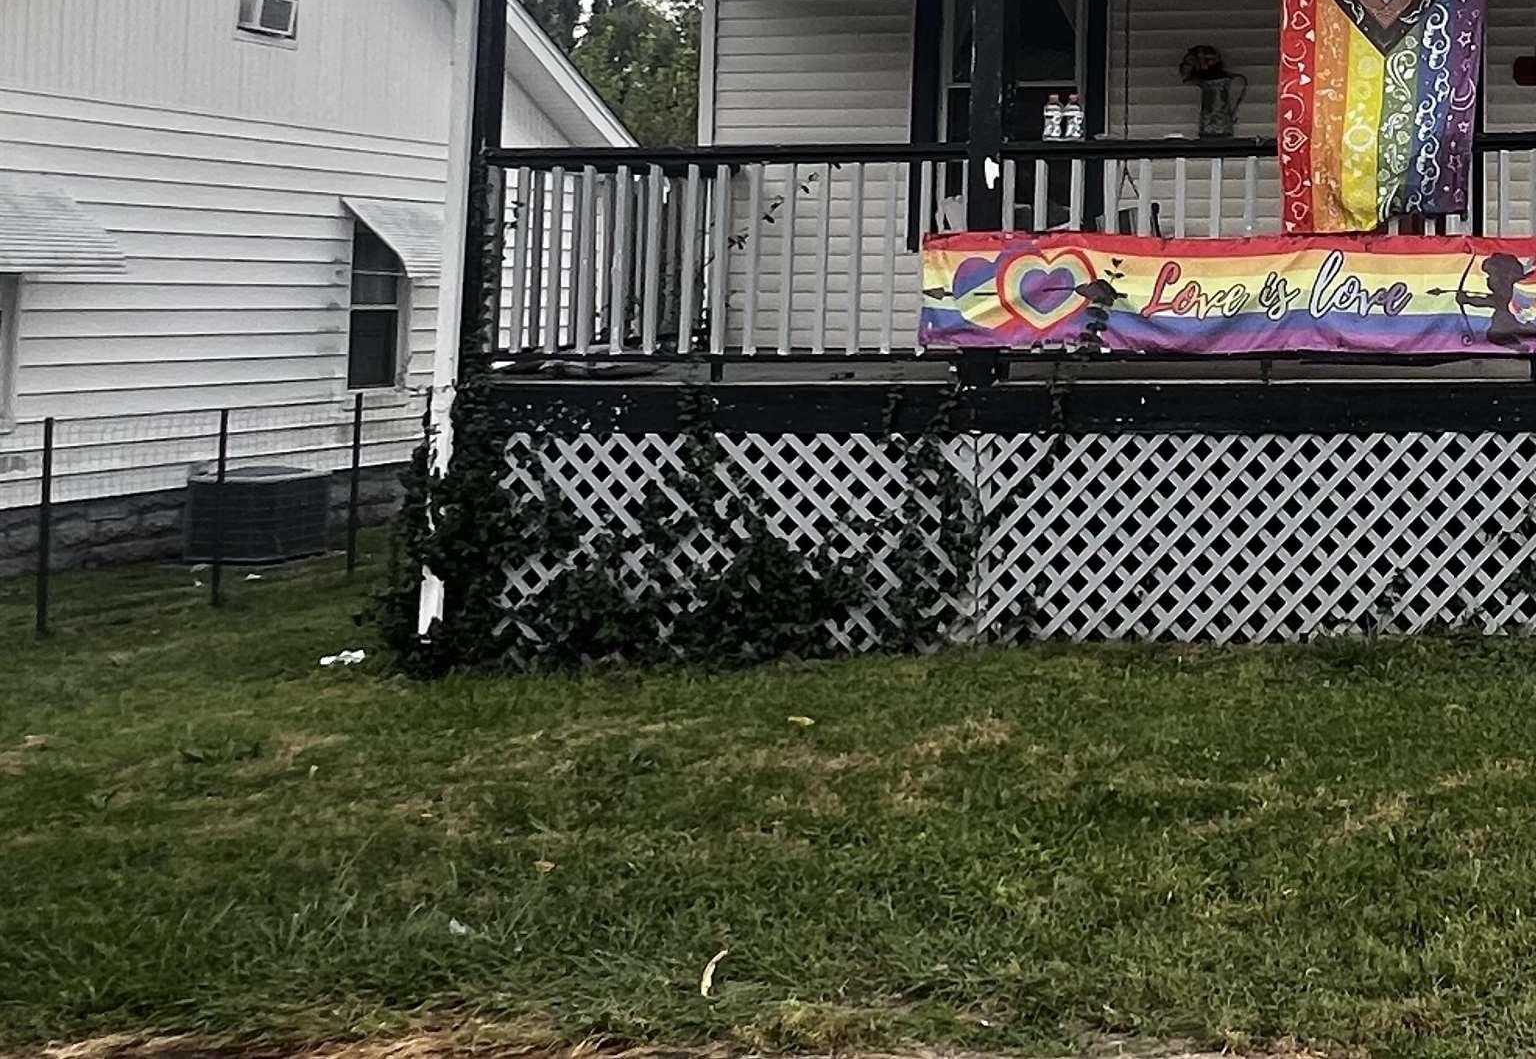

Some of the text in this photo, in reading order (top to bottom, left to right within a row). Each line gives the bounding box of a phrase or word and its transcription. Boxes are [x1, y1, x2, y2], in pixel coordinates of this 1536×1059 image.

[1140, 249, 1413, 322] Love is love
